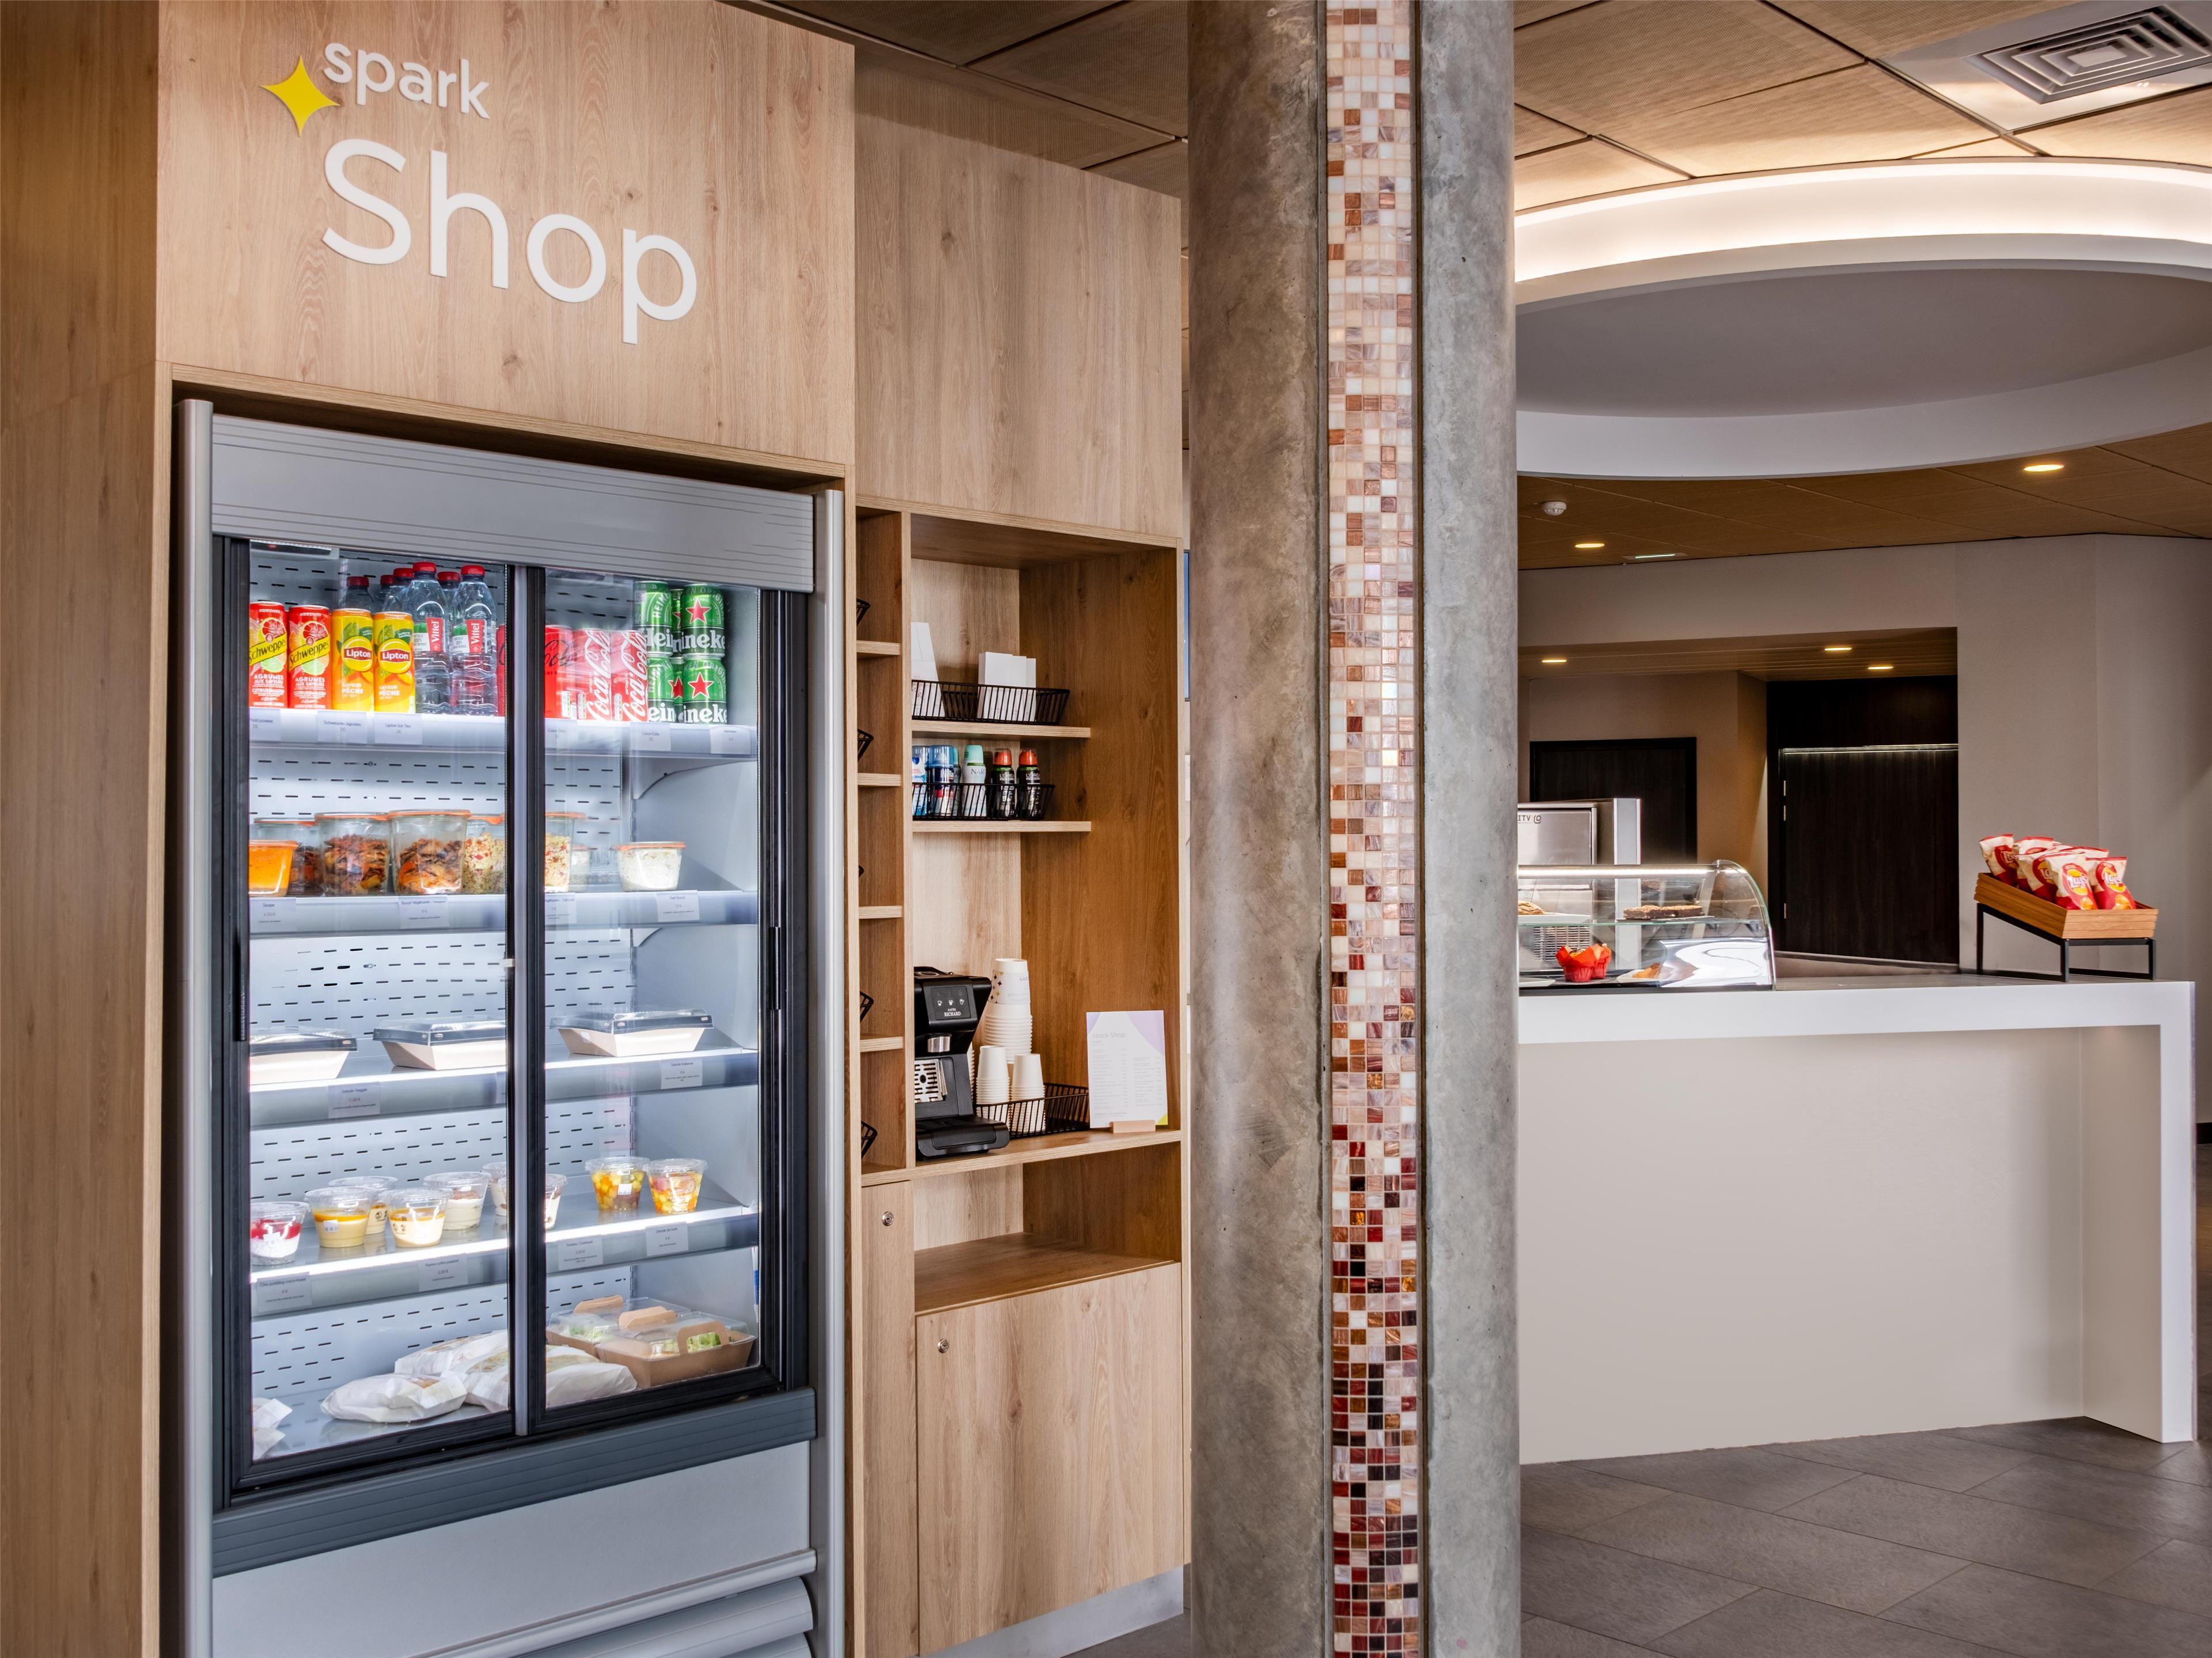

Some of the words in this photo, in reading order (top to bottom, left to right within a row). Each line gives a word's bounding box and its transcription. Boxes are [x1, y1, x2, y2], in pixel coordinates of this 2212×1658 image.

[323, 42, 490, 119] spark
[321, 139, 697, 345] Shop
[431, 621, 440, 643] Vittel
[471, 623, 480, 644] Vittel
[346, 650, 372, 658] Lipton
[382, 652, 409, 661] Lipton
